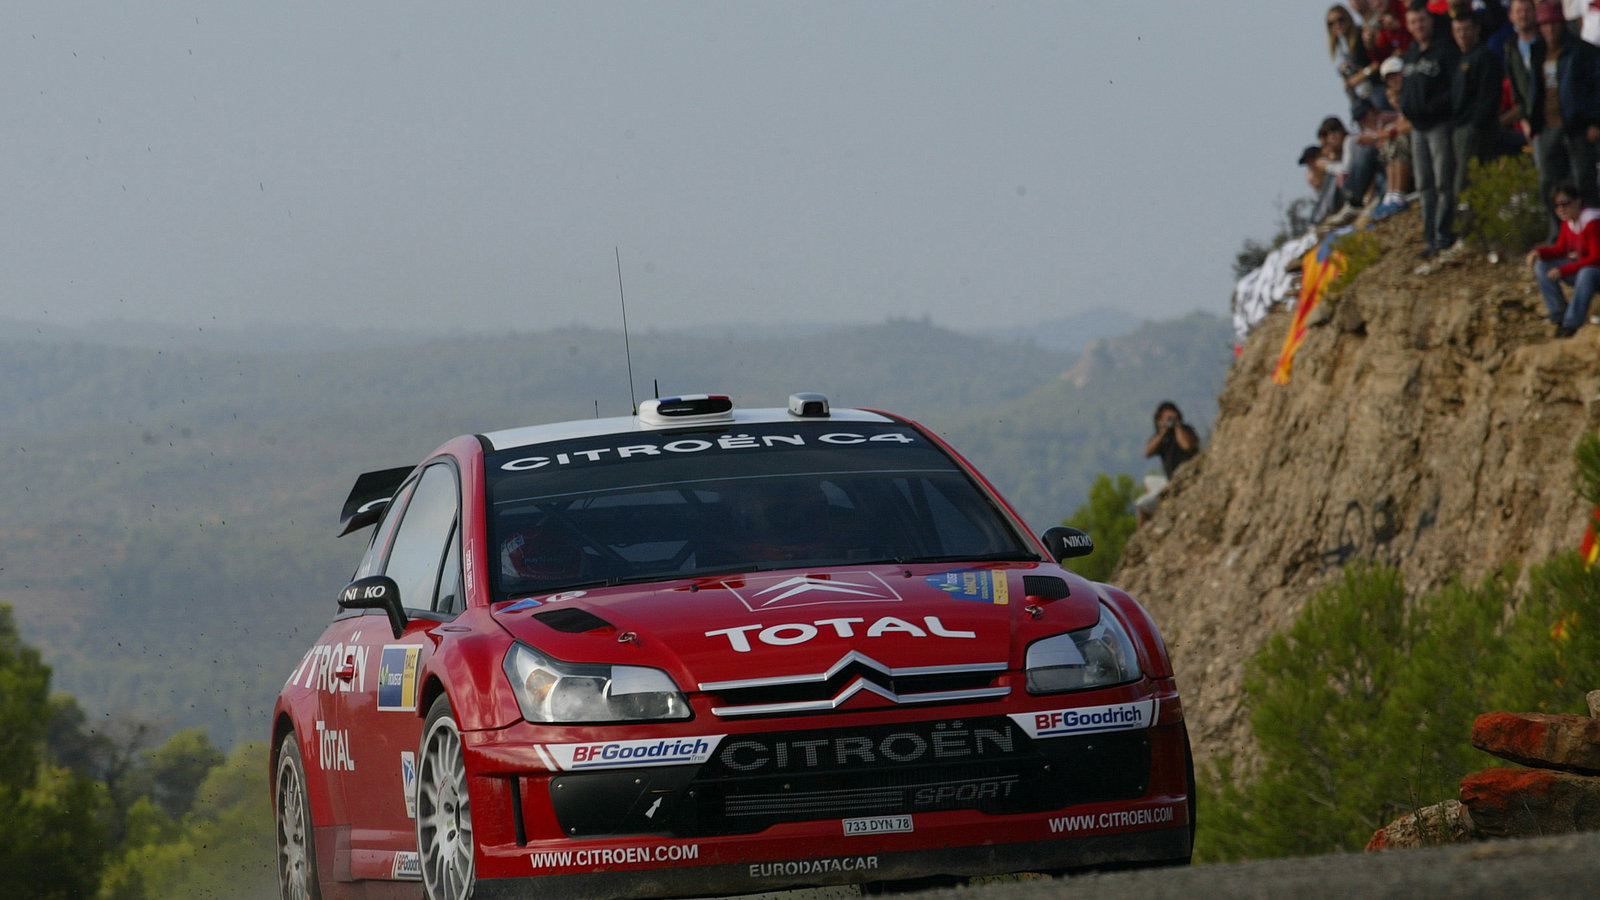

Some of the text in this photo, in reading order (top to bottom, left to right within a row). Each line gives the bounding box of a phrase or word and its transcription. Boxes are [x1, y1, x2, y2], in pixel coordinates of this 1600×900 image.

[500, 433, 914, 471] CITROËN C4
[704, 616, 977, 653] TOTAL
[1034, 706, 1142, 730] BFGoodrich
[315, 720, 355, 771] TOTAL
[572, 739, 709, 762] BFGoodrich
[720, 720, 1013, 771] CITROËN
[914, 779, 1020, 804] SPORT
[846, 818, 910, 832] 733 DYN 78
[1049, 807, 1174, 833] WWW.CITROEN.COM
[530, 844, 699, 868] WWW.CITROEN.COM
[749, 856, 878, 877] EURODATACAR
